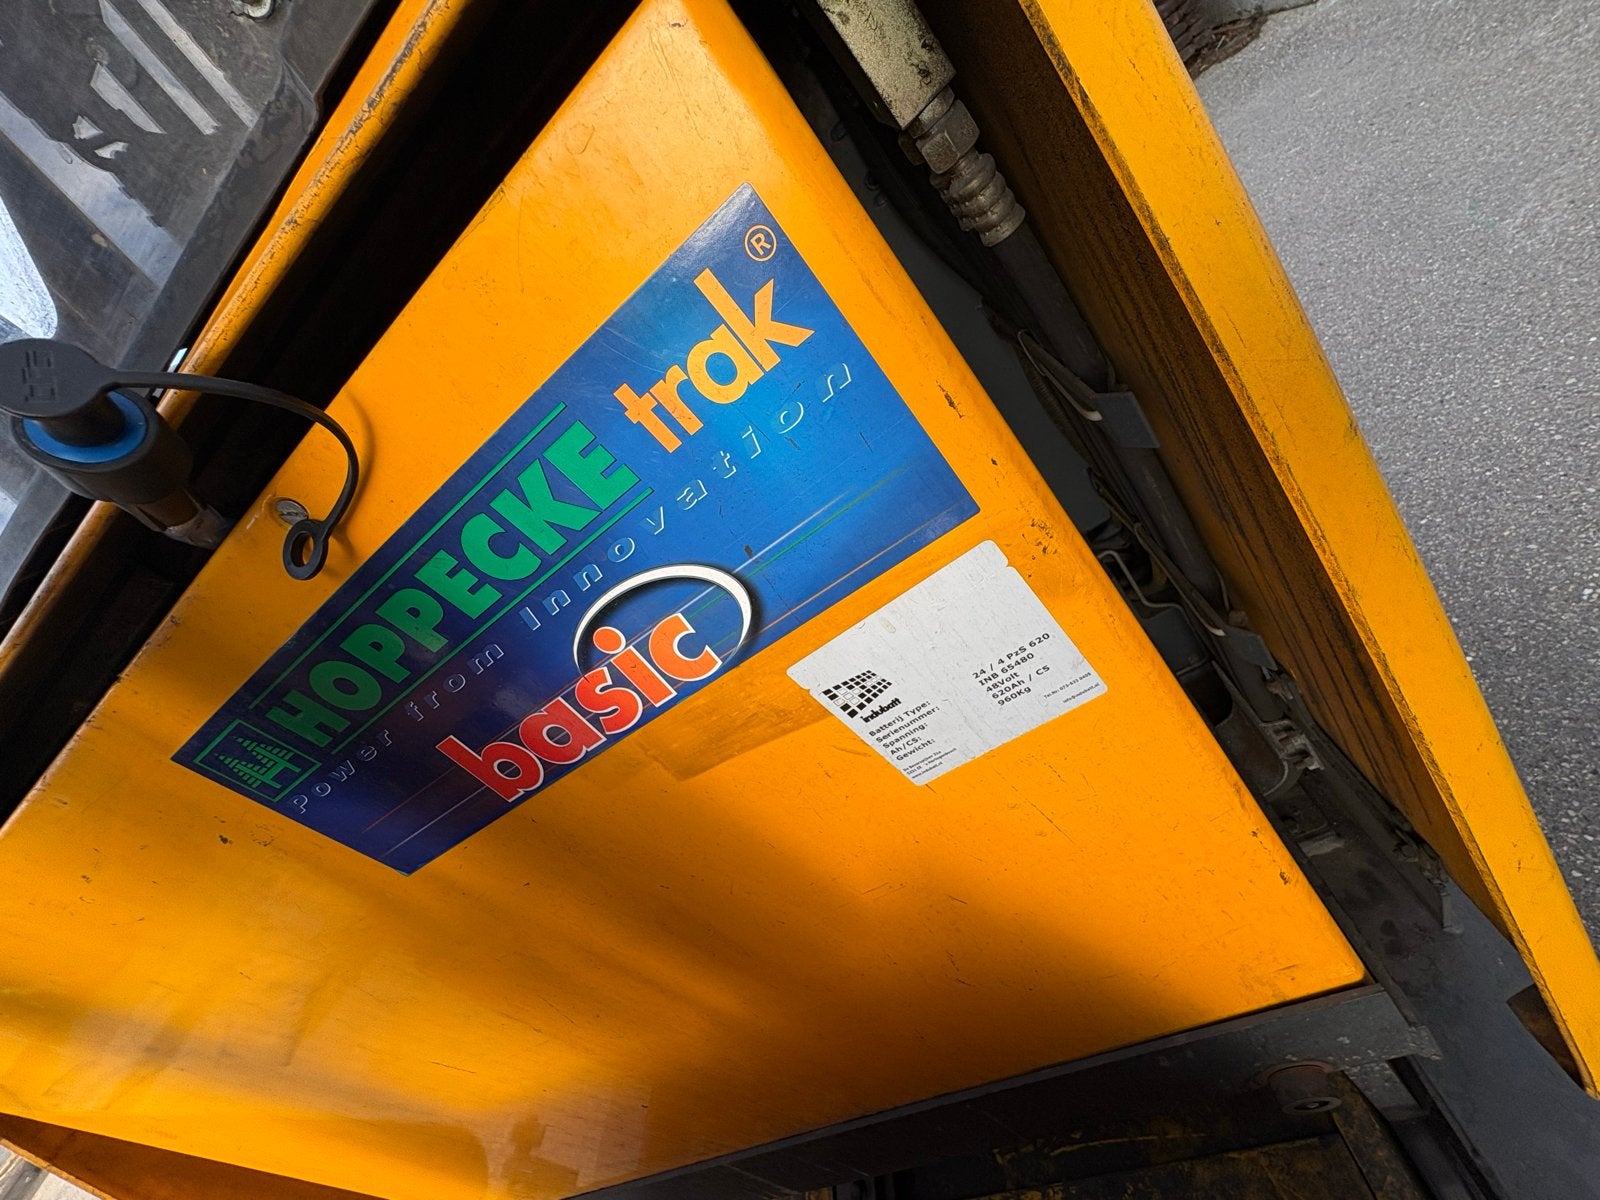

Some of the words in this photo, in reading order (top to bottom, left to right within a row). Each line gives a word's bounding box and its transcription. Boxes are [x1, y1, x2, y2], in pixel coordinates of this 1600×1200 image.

[264, 420, 642, 750] HOPPECKE
[612, 267, 815, 454] trak
[291, 729, 392, 814] Power
[404, 644, 504, 722] from
[518, 361, 852, 631] Innovation
[435, 612, 723, 803] basic
[860, 697, 902, 723] indubatt
[868, 715, 904, 737] Batterij
[903, 700, 931, 717] Type:
[972, 668, 986, 679] 24
[1006, 645, 1027, 660] PzS
[1028, 632, 1050, 648] 620
[876, 706, 940, 743] Serienummer:
[979, 672, 999, 686] INB
[1000, 652, 1034, 674] 65480
[882, 723, 928, 749] Spanning:
[986, 672, 1020, 692] 48Volt
[896, 738, 935, 761] Gewicht:
[997, 686, 1032, 706] 960Kg
[992, 679, 1025, 699] 620Ah
